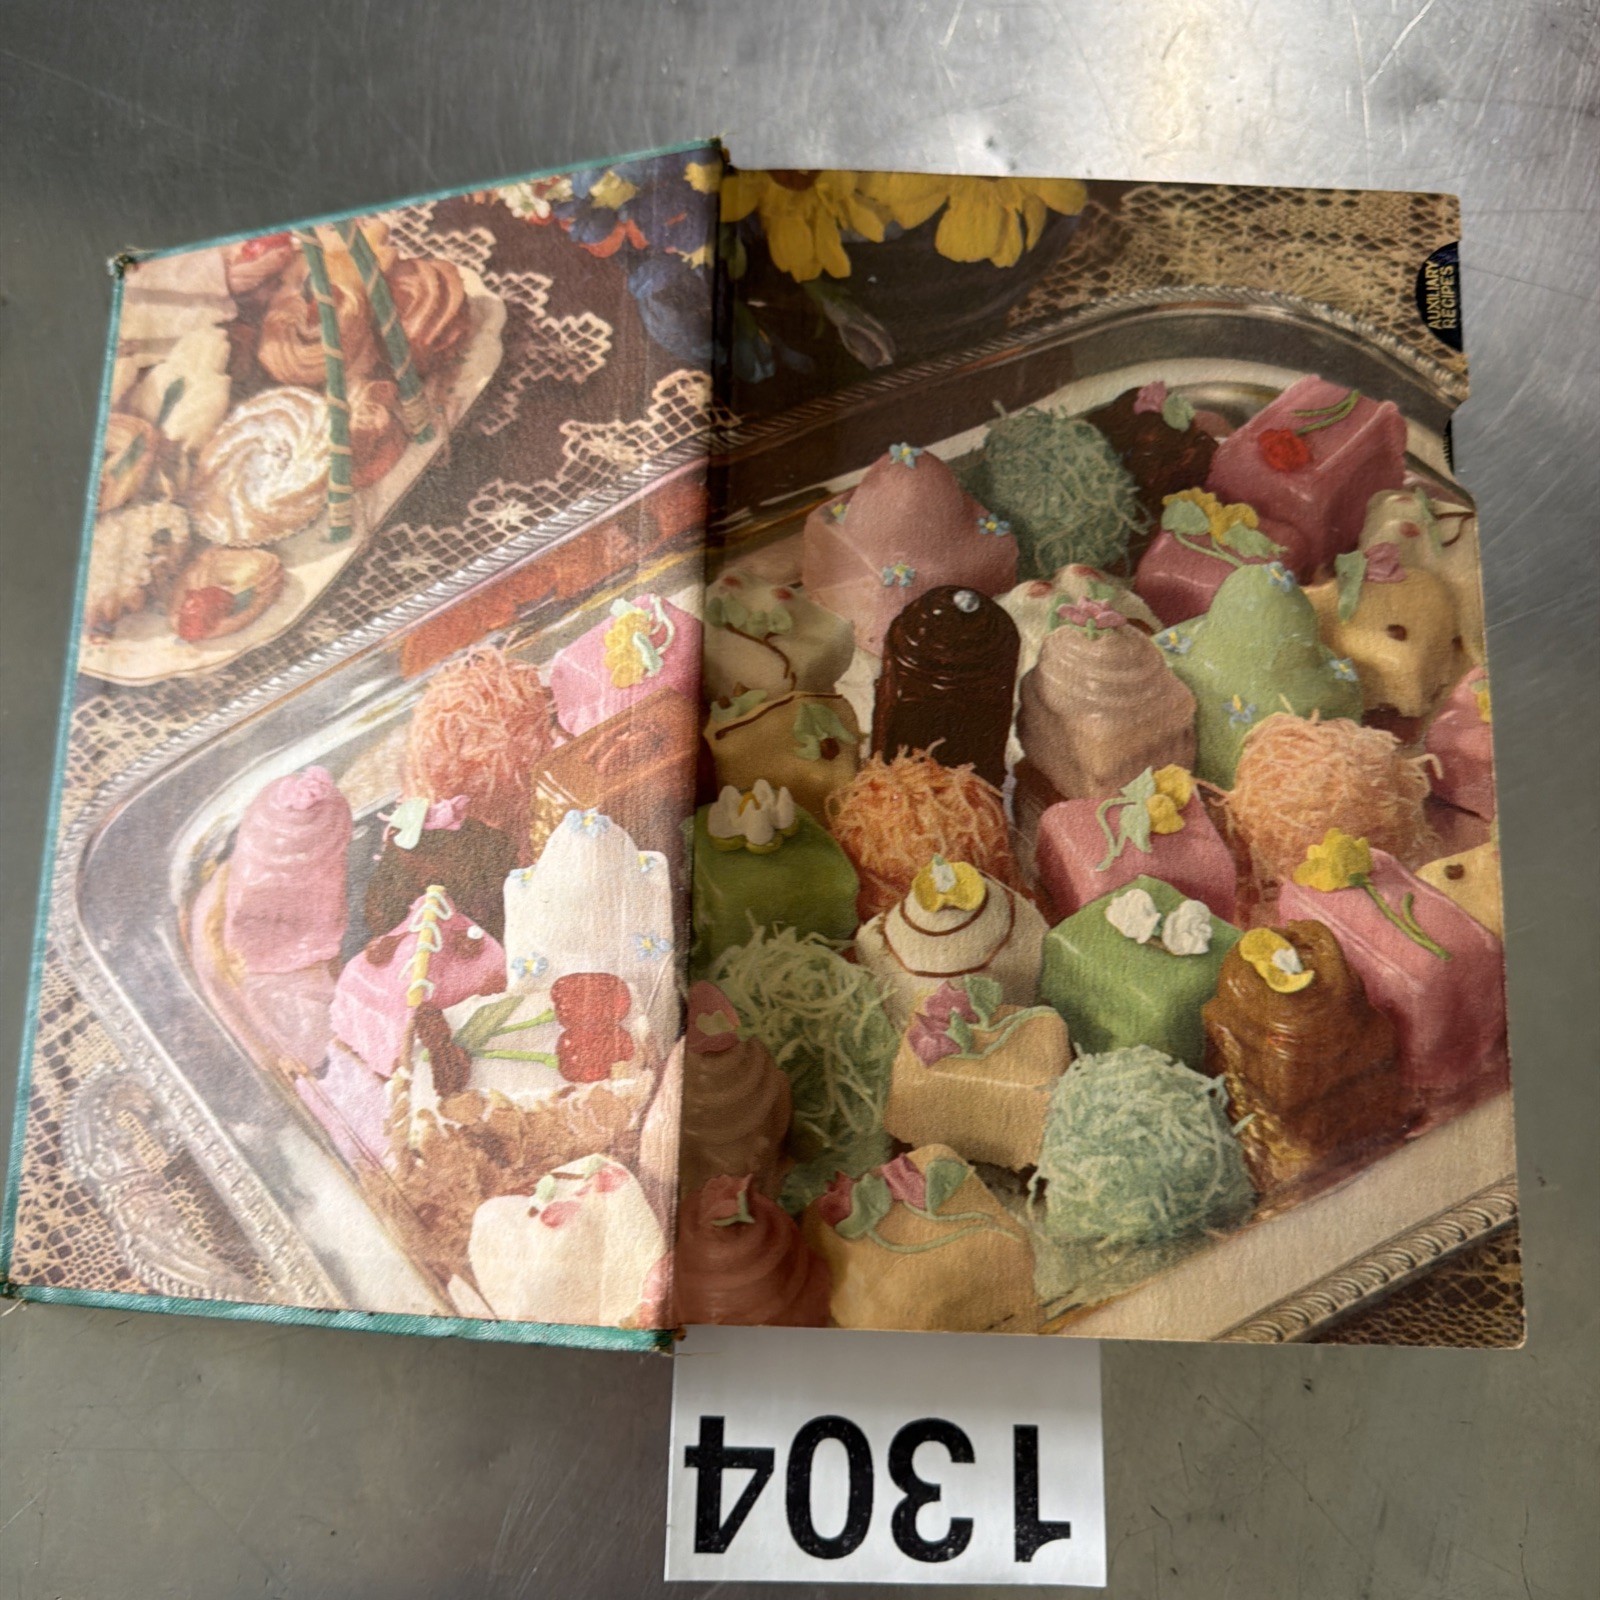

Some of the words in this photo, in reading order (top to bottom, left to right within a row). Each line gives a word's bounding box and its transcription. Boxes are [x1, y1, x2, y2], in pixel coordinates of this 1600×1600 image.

[1425, 261, 1442, 329] AUXILIARY
[1440, 265, 1457, 329] RECIPES
[684, 1414, 1071, 1563] 1304
